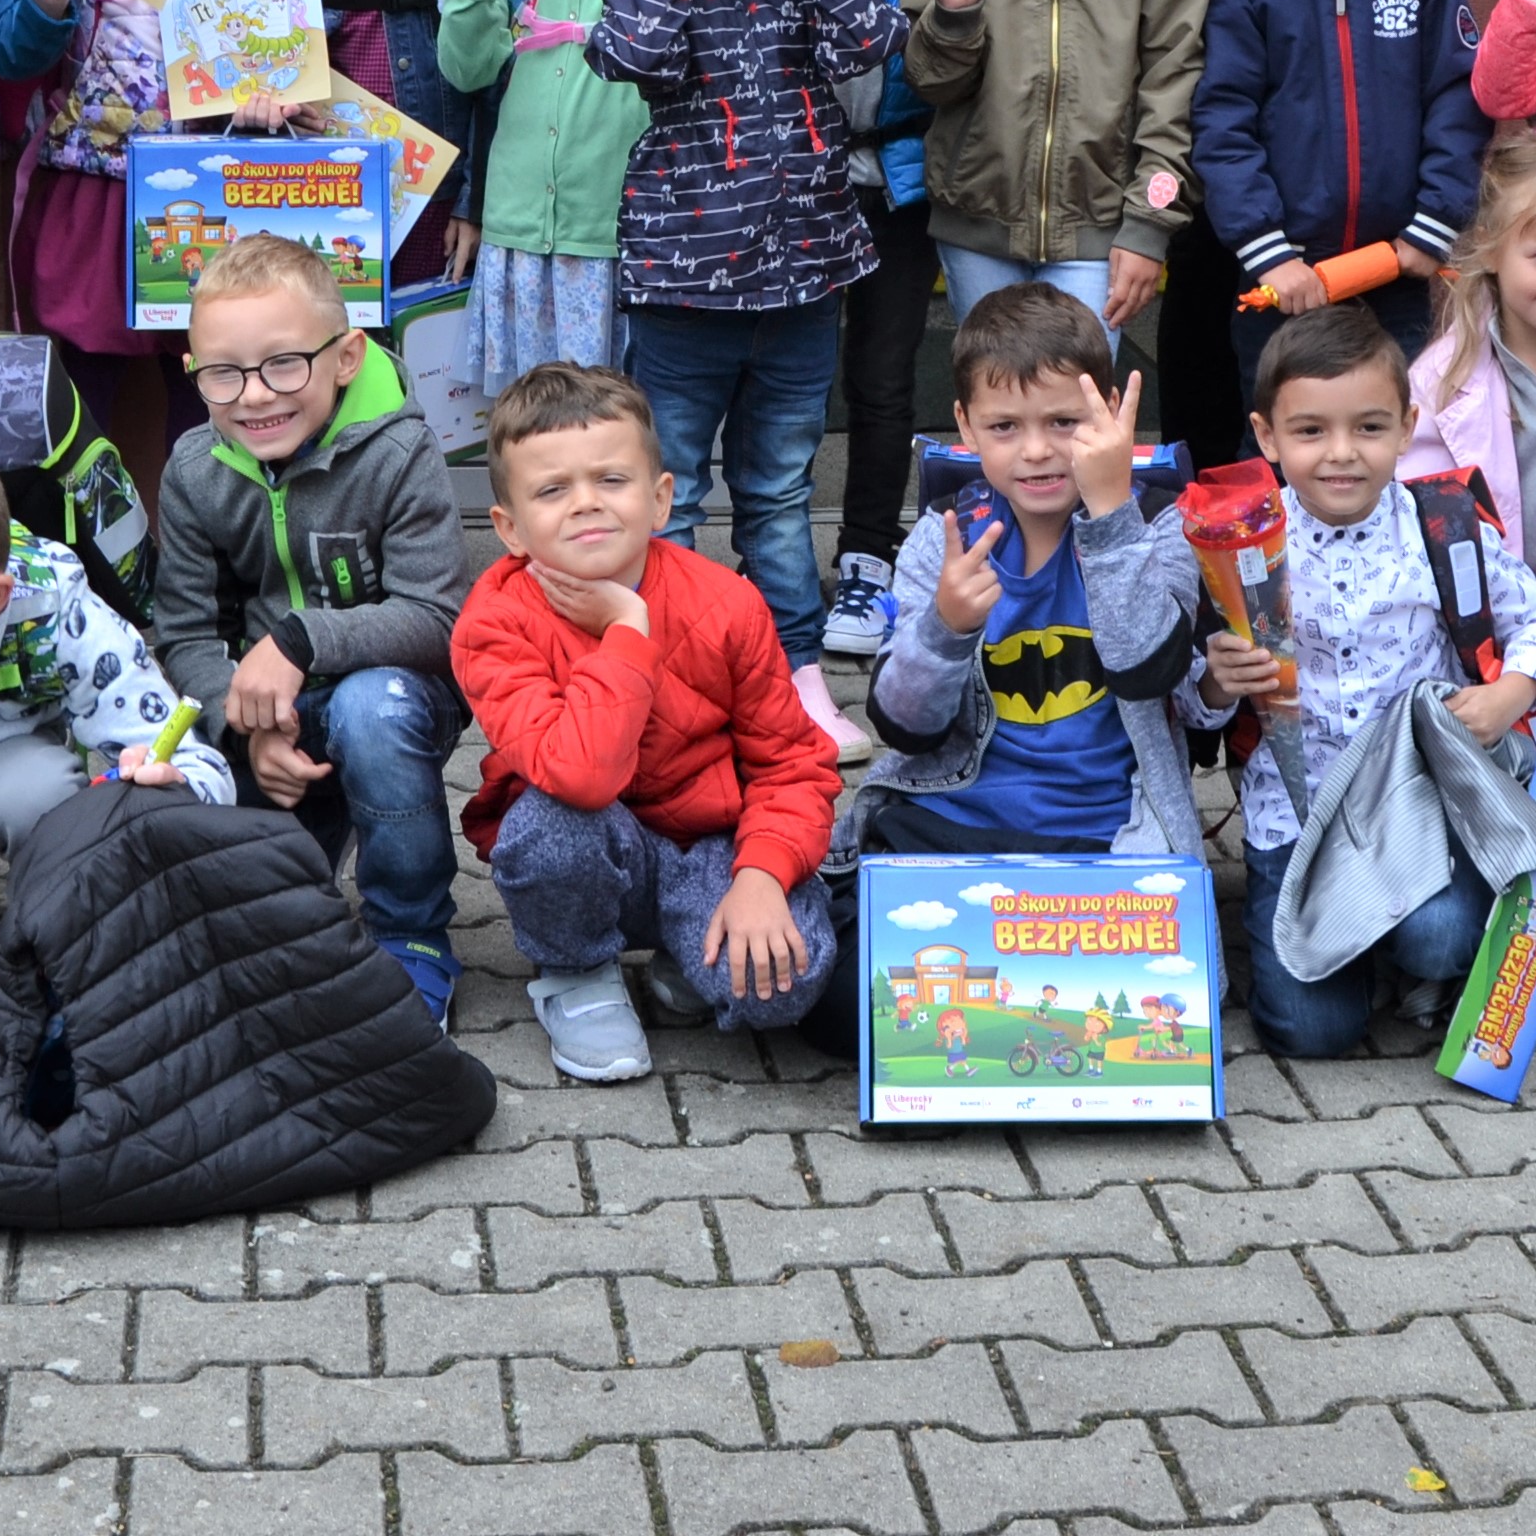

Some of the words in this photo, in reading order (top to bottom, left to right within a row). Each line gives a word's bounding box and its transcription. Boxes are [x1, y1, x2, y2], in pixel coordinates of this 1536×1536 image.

[190, 2, 215, 25] Tt
[1383, 7, 1408, 31] 62
[223, 164, 241, 177] DO
[243, 162, 279, 178] ŠKOLY
[281, 165, 286, 176] I
[288, 165, 305, 177] DO
[307, 161, 360, 178] PŘÍRODY
[224, 178, 361, 206] BEZPEČNĚ!
[993, 896, 1015, 912] DO
[1018, 891, 1067, 913] ŠKOLY
[1071, 896, 1077, 911] I
[1081, 897, 1102, 913] DO
[1105, 892, 1175, 913] PŘÍRODY
[994, 916, 1177, 952] BEZPEČNĚ!
[1478, 934, 1533, 1044] BEZPEČNĚ!
[893, 1094, 933, 1104] Liberecký
[910, 1101, 926, 1112] kraj
